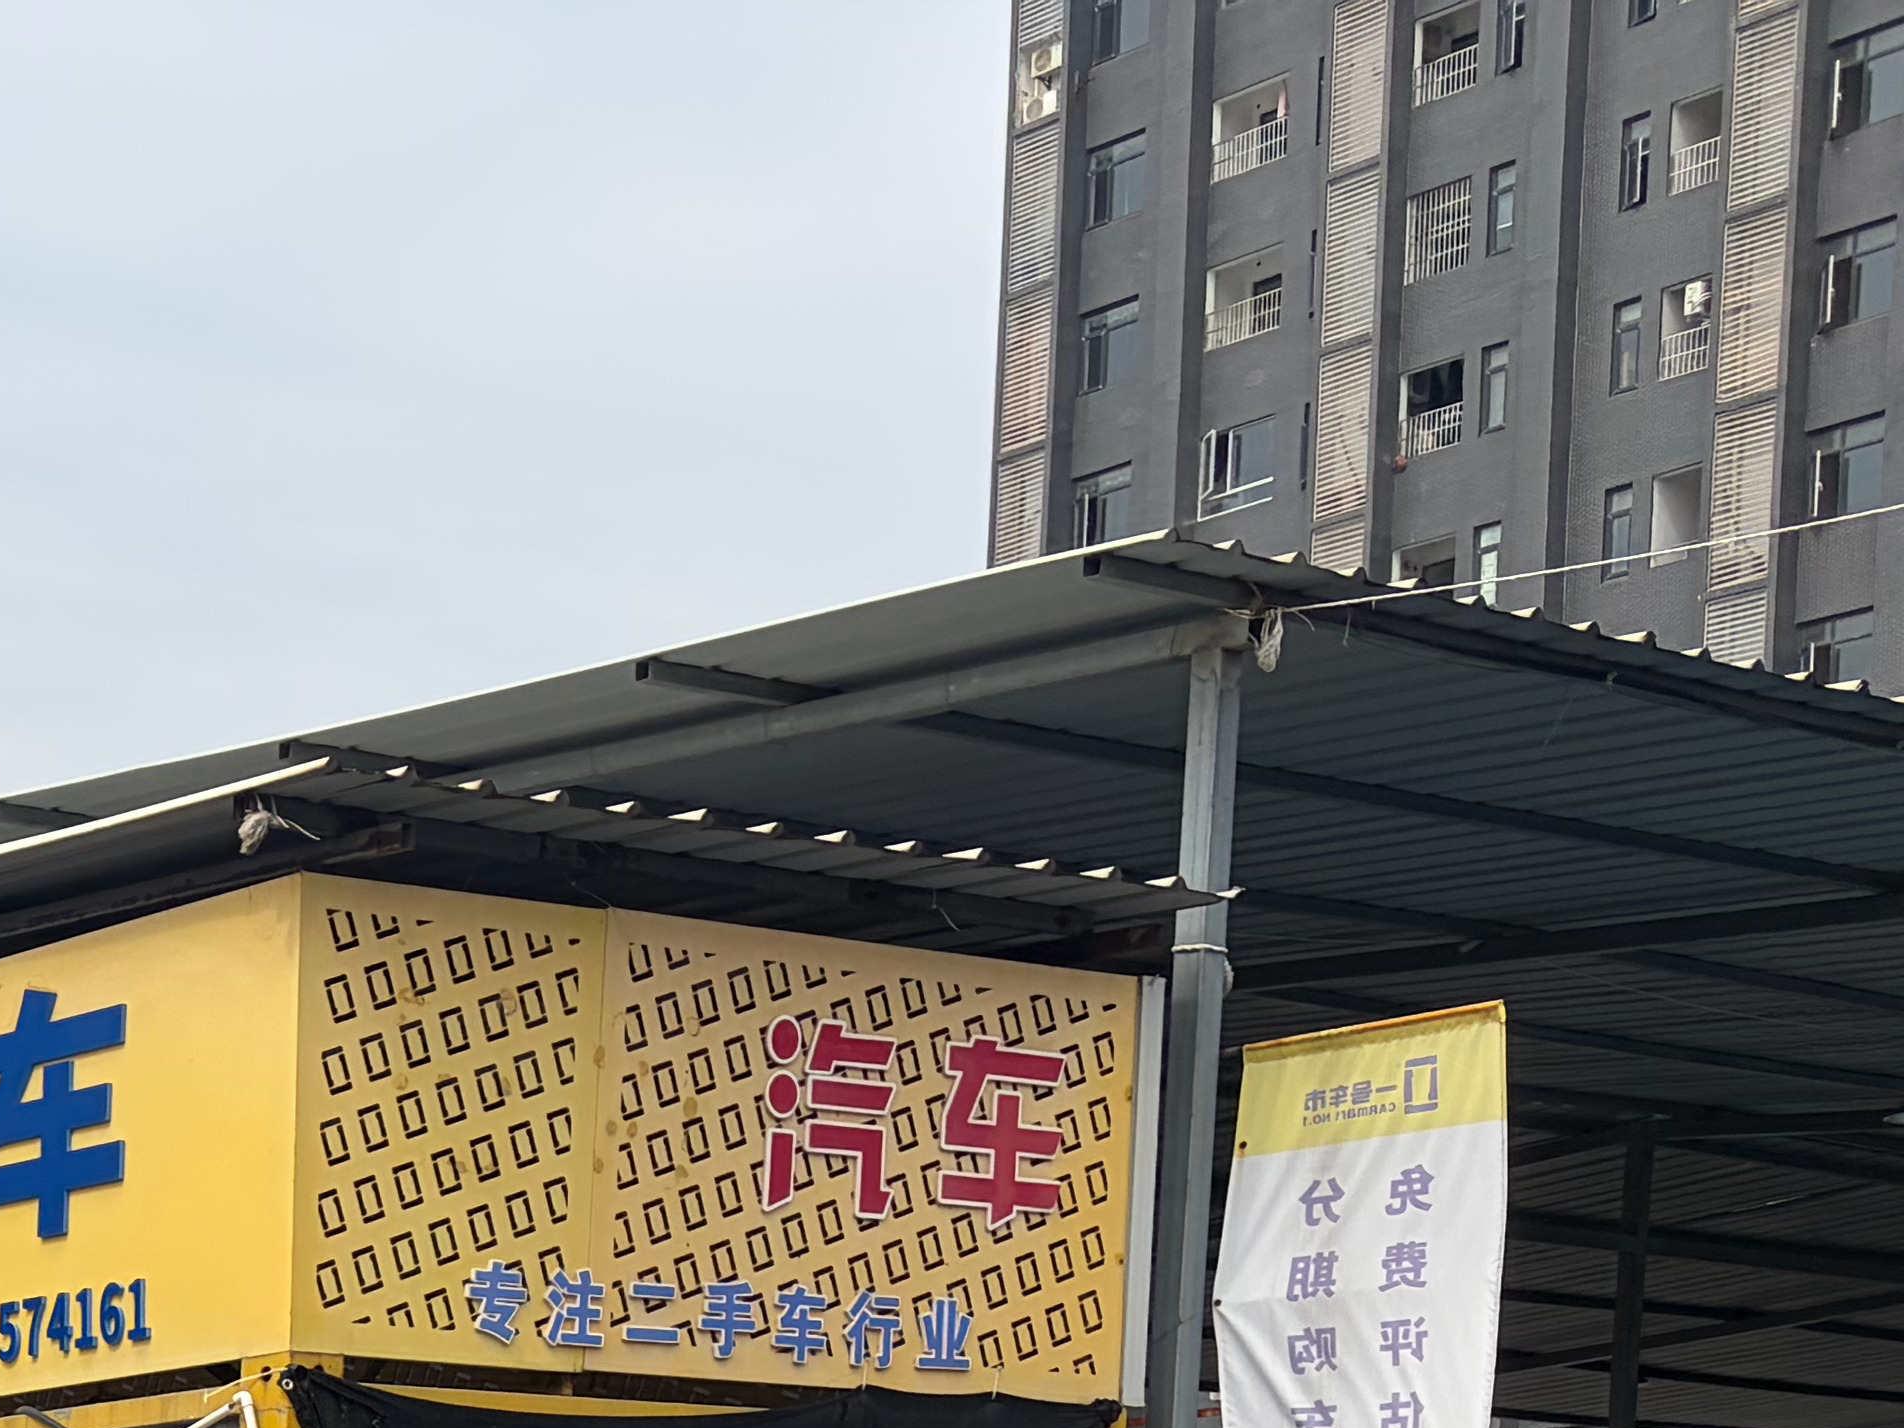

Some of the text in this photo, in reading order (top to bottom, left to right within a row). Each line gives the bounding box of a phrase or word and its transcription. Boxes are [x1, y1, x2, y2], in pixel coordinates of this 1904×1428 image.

[762, 1013, 1069, 1233] 汽车
[464, 1258, 974, 1372] 专注二手车行业
